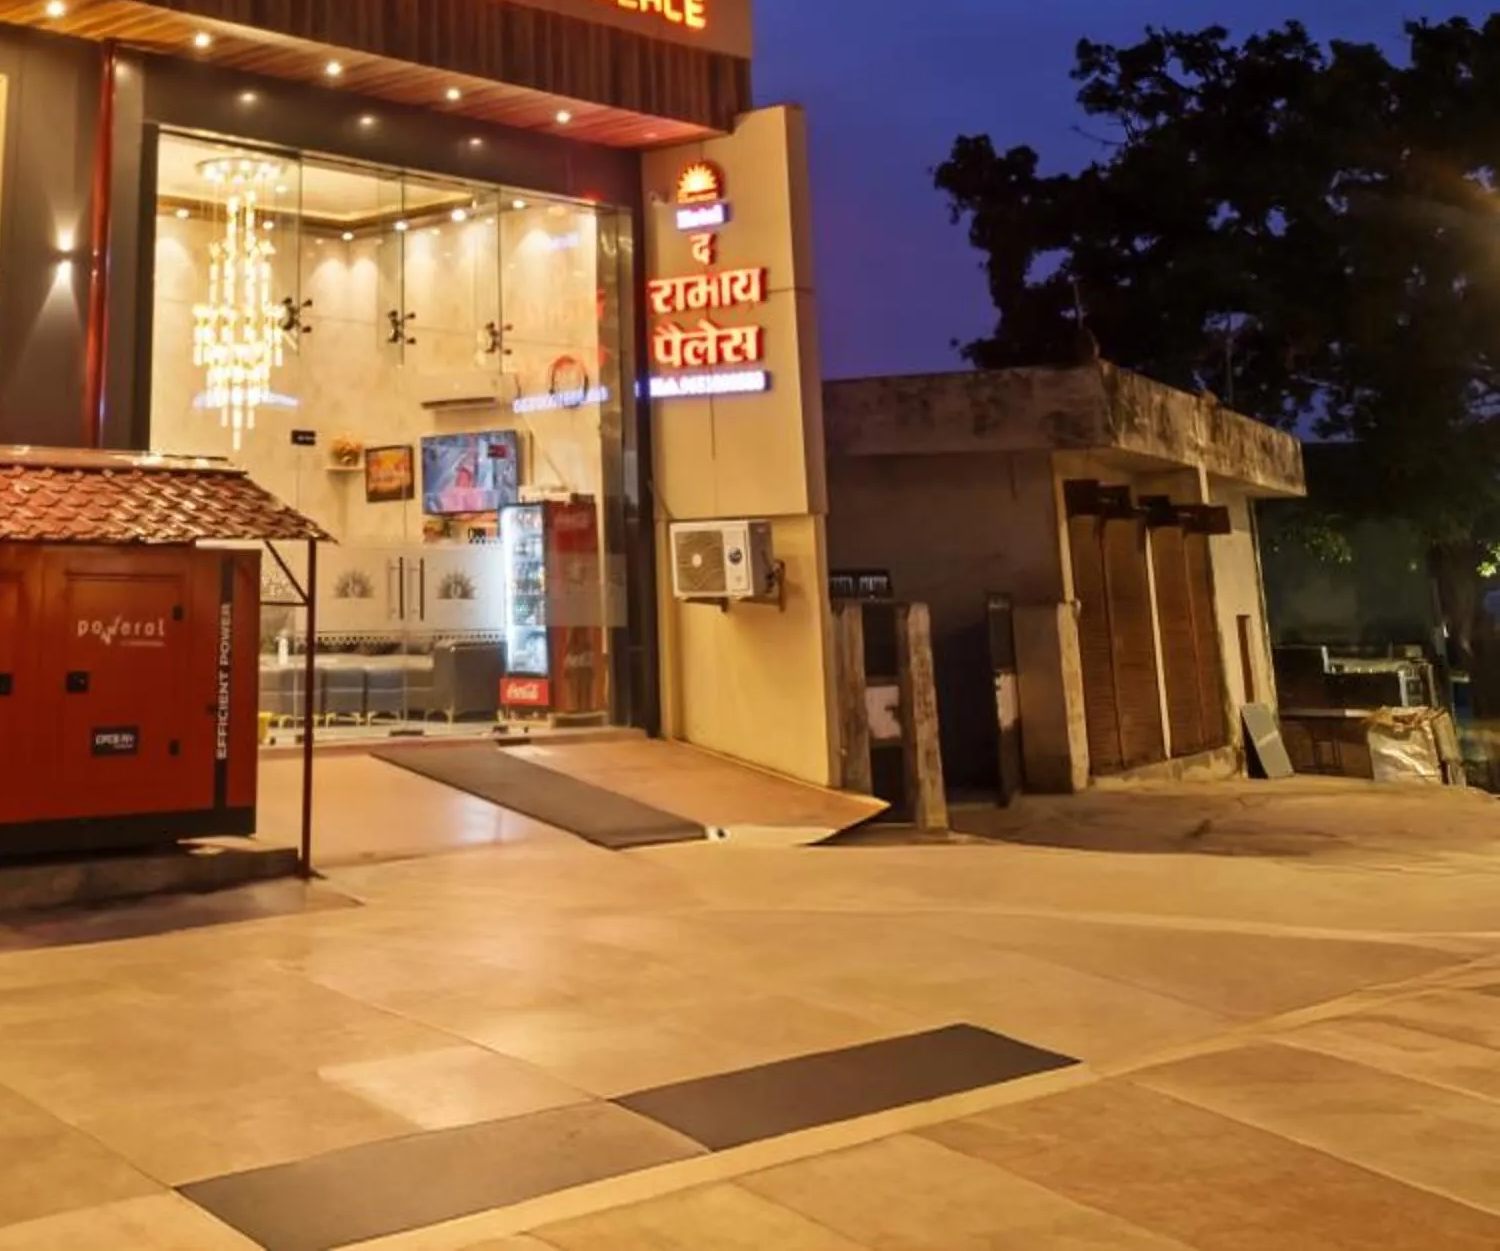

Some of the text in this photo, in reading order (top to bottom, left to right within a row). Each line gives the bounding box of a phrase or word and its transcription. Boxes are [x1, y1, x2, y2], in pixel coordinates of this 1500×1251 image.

[690, 233, 712, 264] द
[649, 268, 763, 314] रामाय
[654, 319, 760, 366] पैलेस
[216, 603, 232, 760] EFFICIENT POWER
